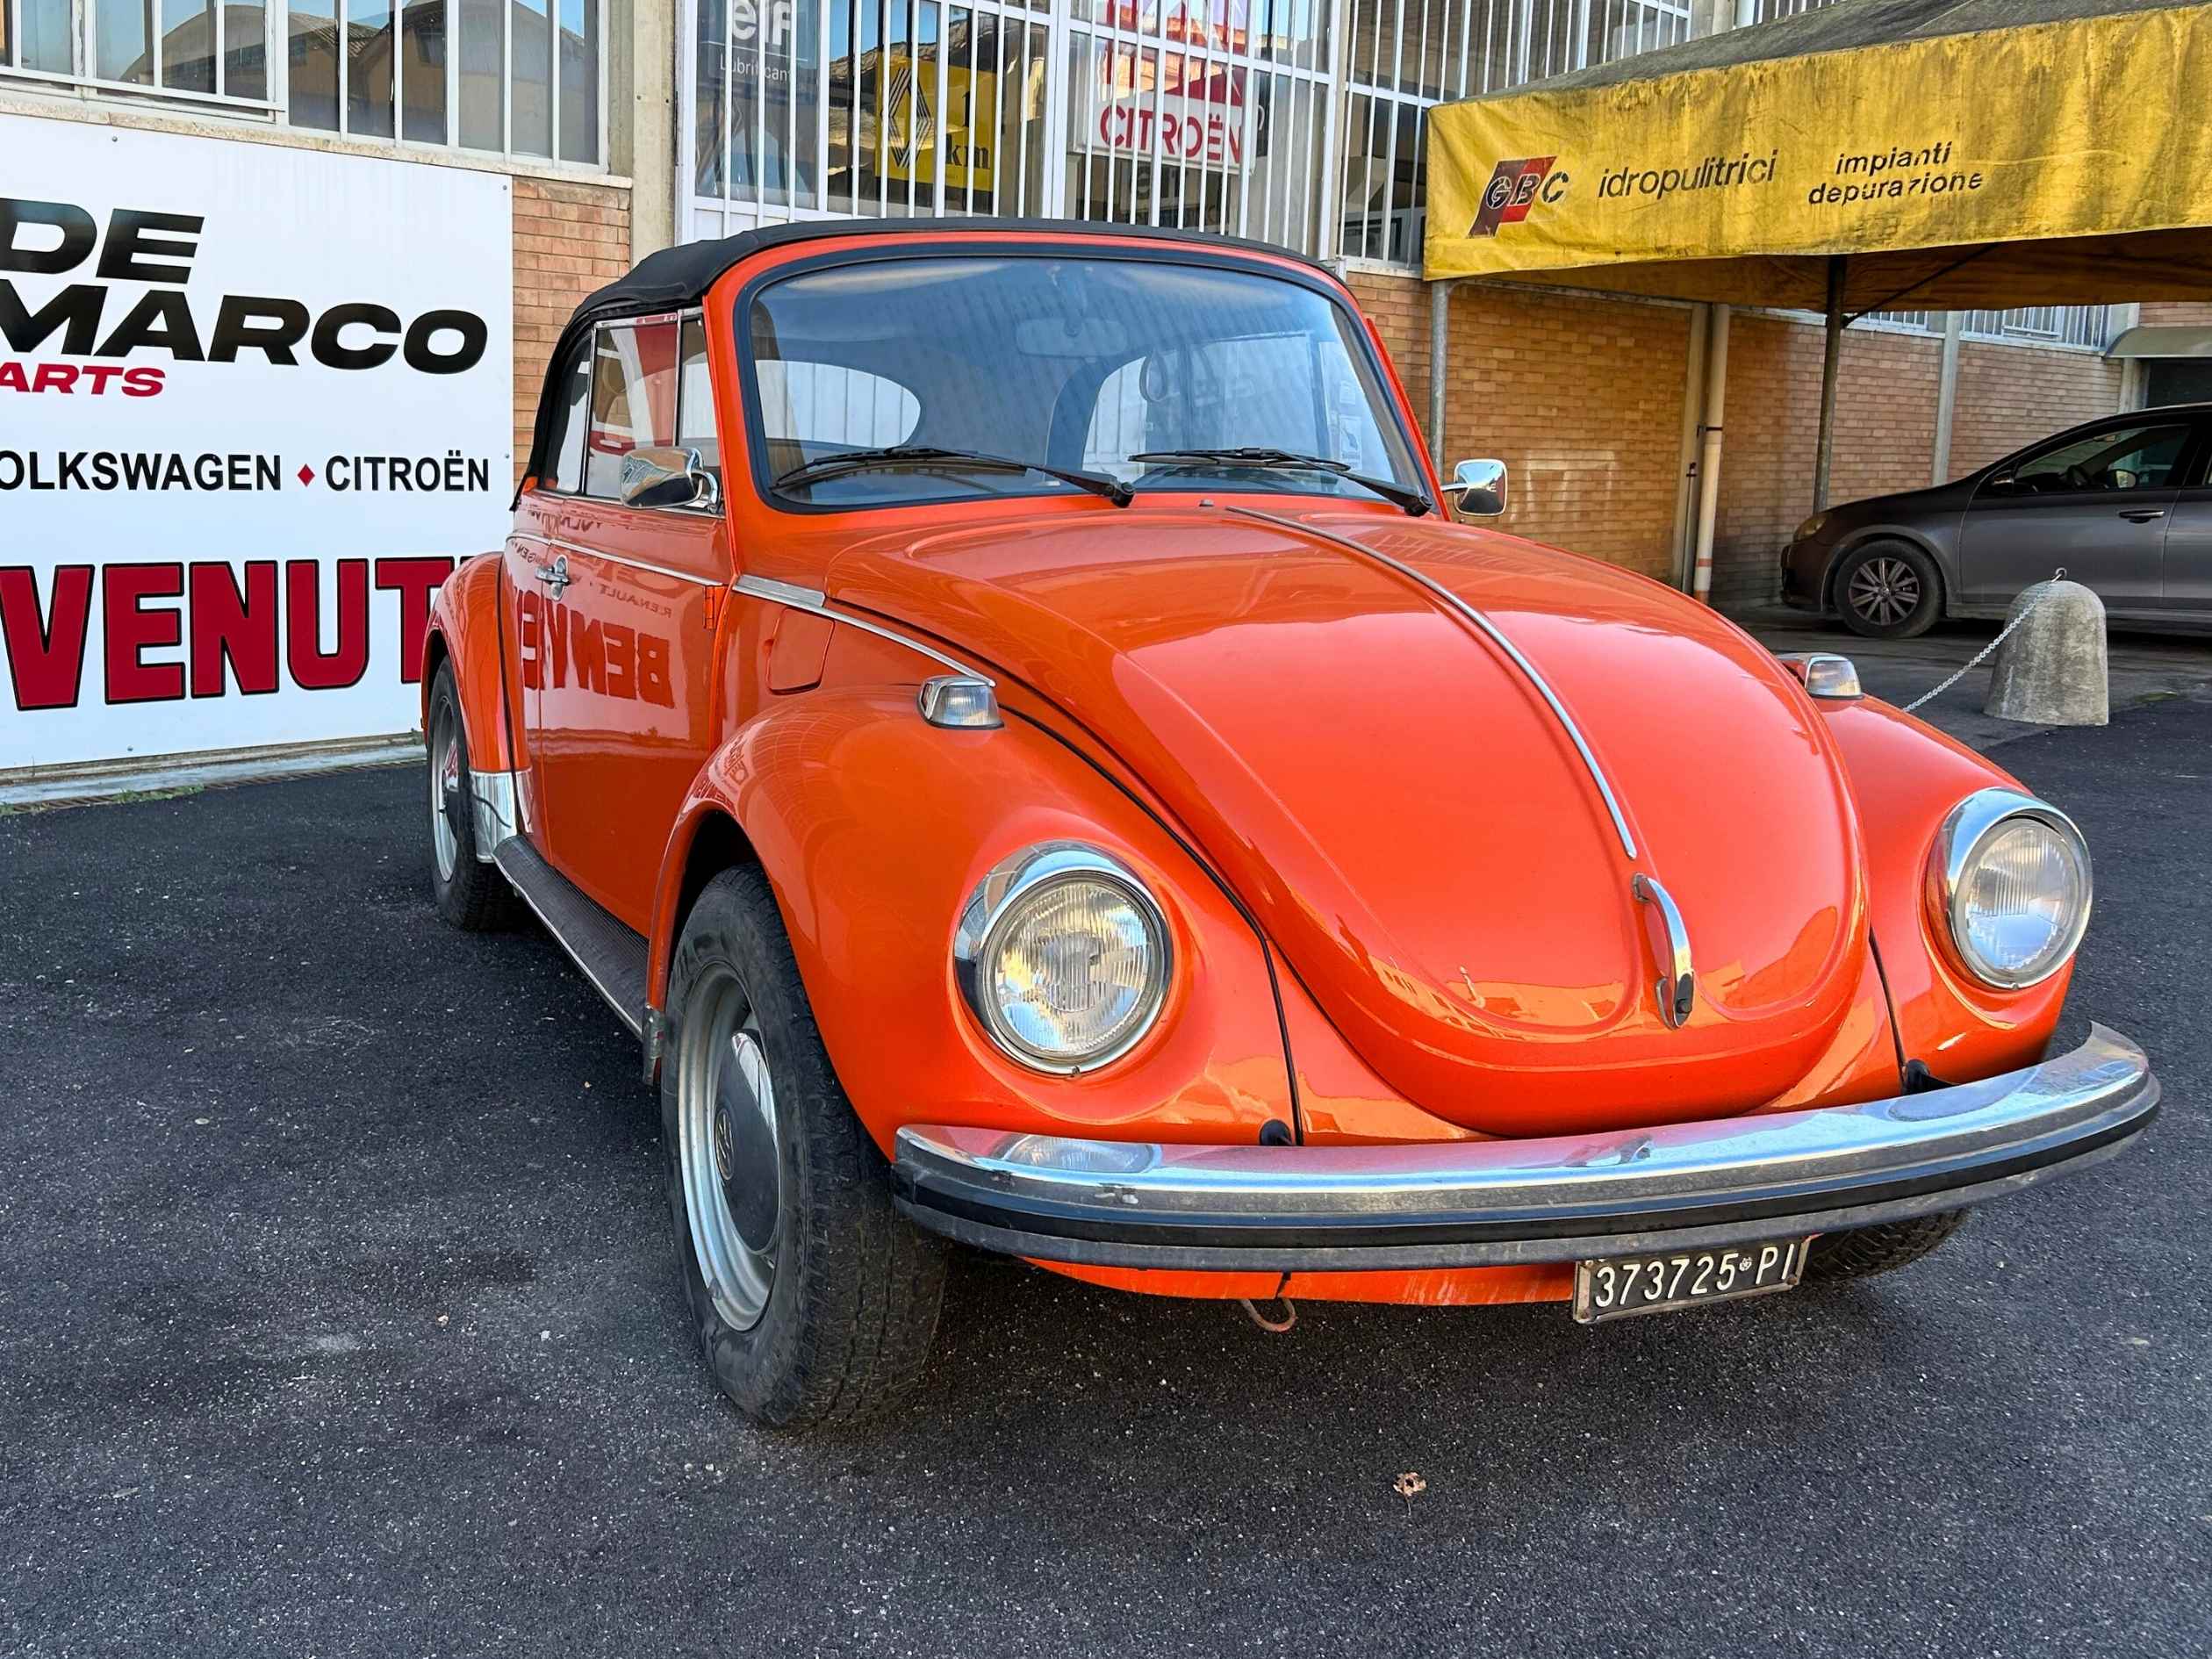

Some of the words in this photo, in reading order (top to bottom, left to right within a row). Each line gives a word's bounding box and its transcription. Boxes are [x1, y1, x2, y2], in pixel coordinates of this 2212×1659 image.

[945, 133, 990, 170] km
[1100, 104, 1242, 164] CITROËN
[1835, 141, 1953, 176] impianti
[1485, 171, 1569, 210] GBC
[1598, 149, 1778, 200] idropulitrici
[1808, 172, 1984, 206] depurazione
[0, 279, 488, 375] MARCO
[326, 449, 490, 492] CITROËN
[1595, 1253, 1740, 1308] 373725
